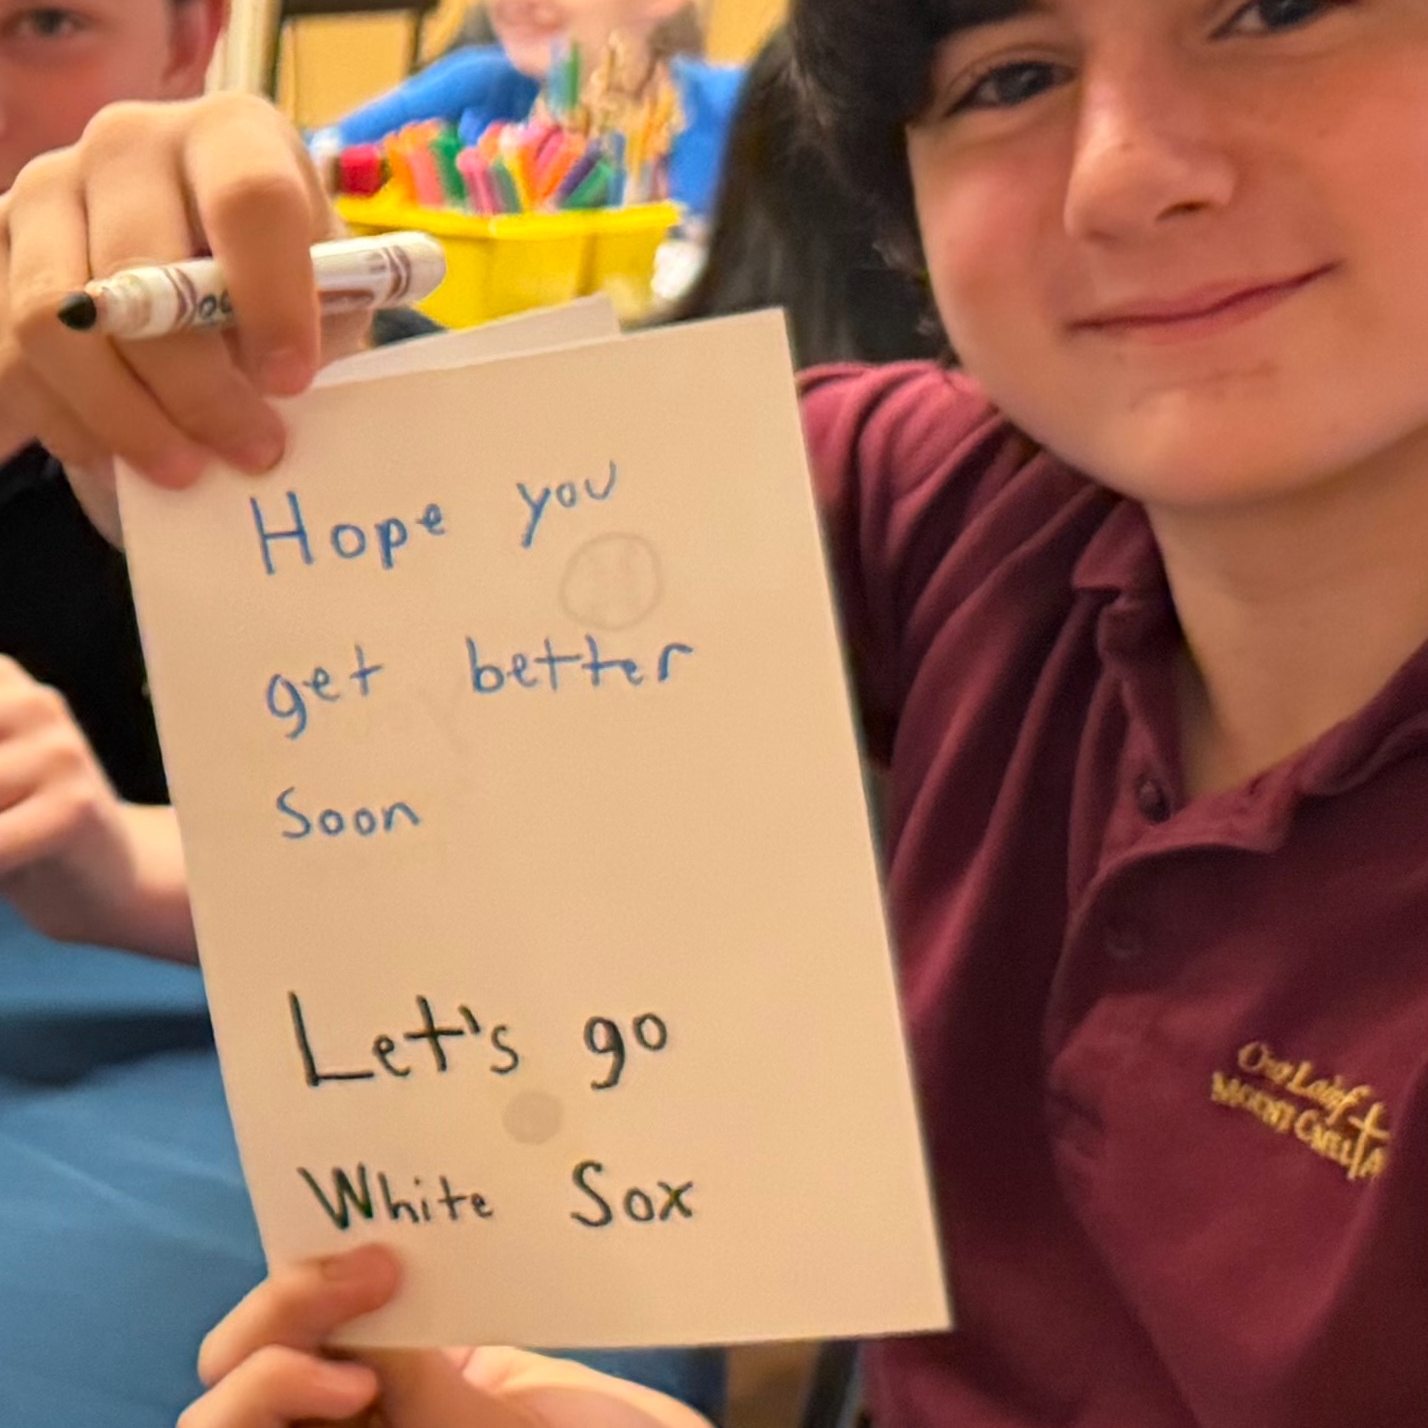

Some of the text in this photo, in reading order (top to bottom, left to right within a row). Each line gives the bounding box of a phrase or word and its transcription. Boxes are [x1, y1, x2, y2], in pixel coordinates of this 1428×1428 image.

[249, 461, 618, 577] Hope you
[264, 634, 695, 741] get better
[275, 786, 422, 841] Soon
[288, 990, 669, 1091] Let's go
[296, 1159, 696, 1233] White Sox
